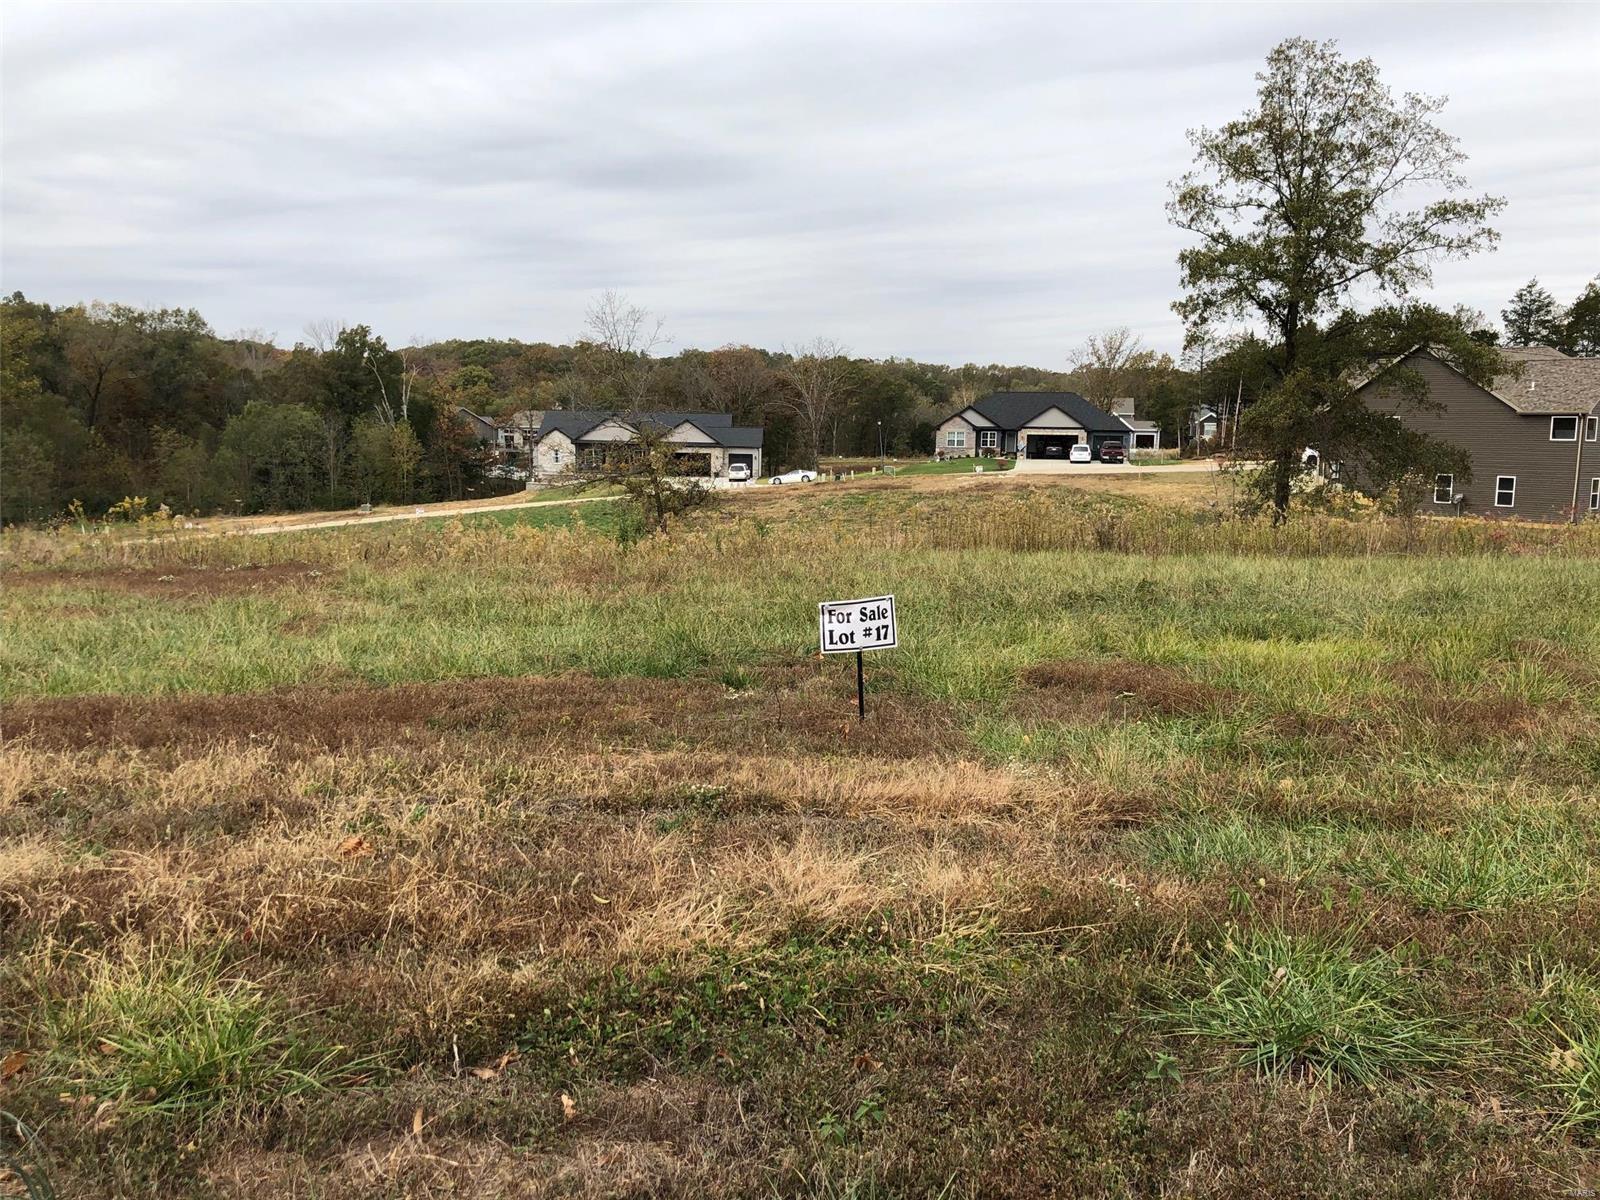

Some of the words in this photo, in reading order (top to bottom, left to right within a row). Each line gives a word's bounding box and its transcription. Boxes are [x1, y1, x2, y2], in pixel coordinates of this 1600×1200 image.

[827, 609, 852, 624] For
[859, 605, 888, 622] Sale
[828, 630, 855, 645] Lot
[862, 624, 889, 641] #17
